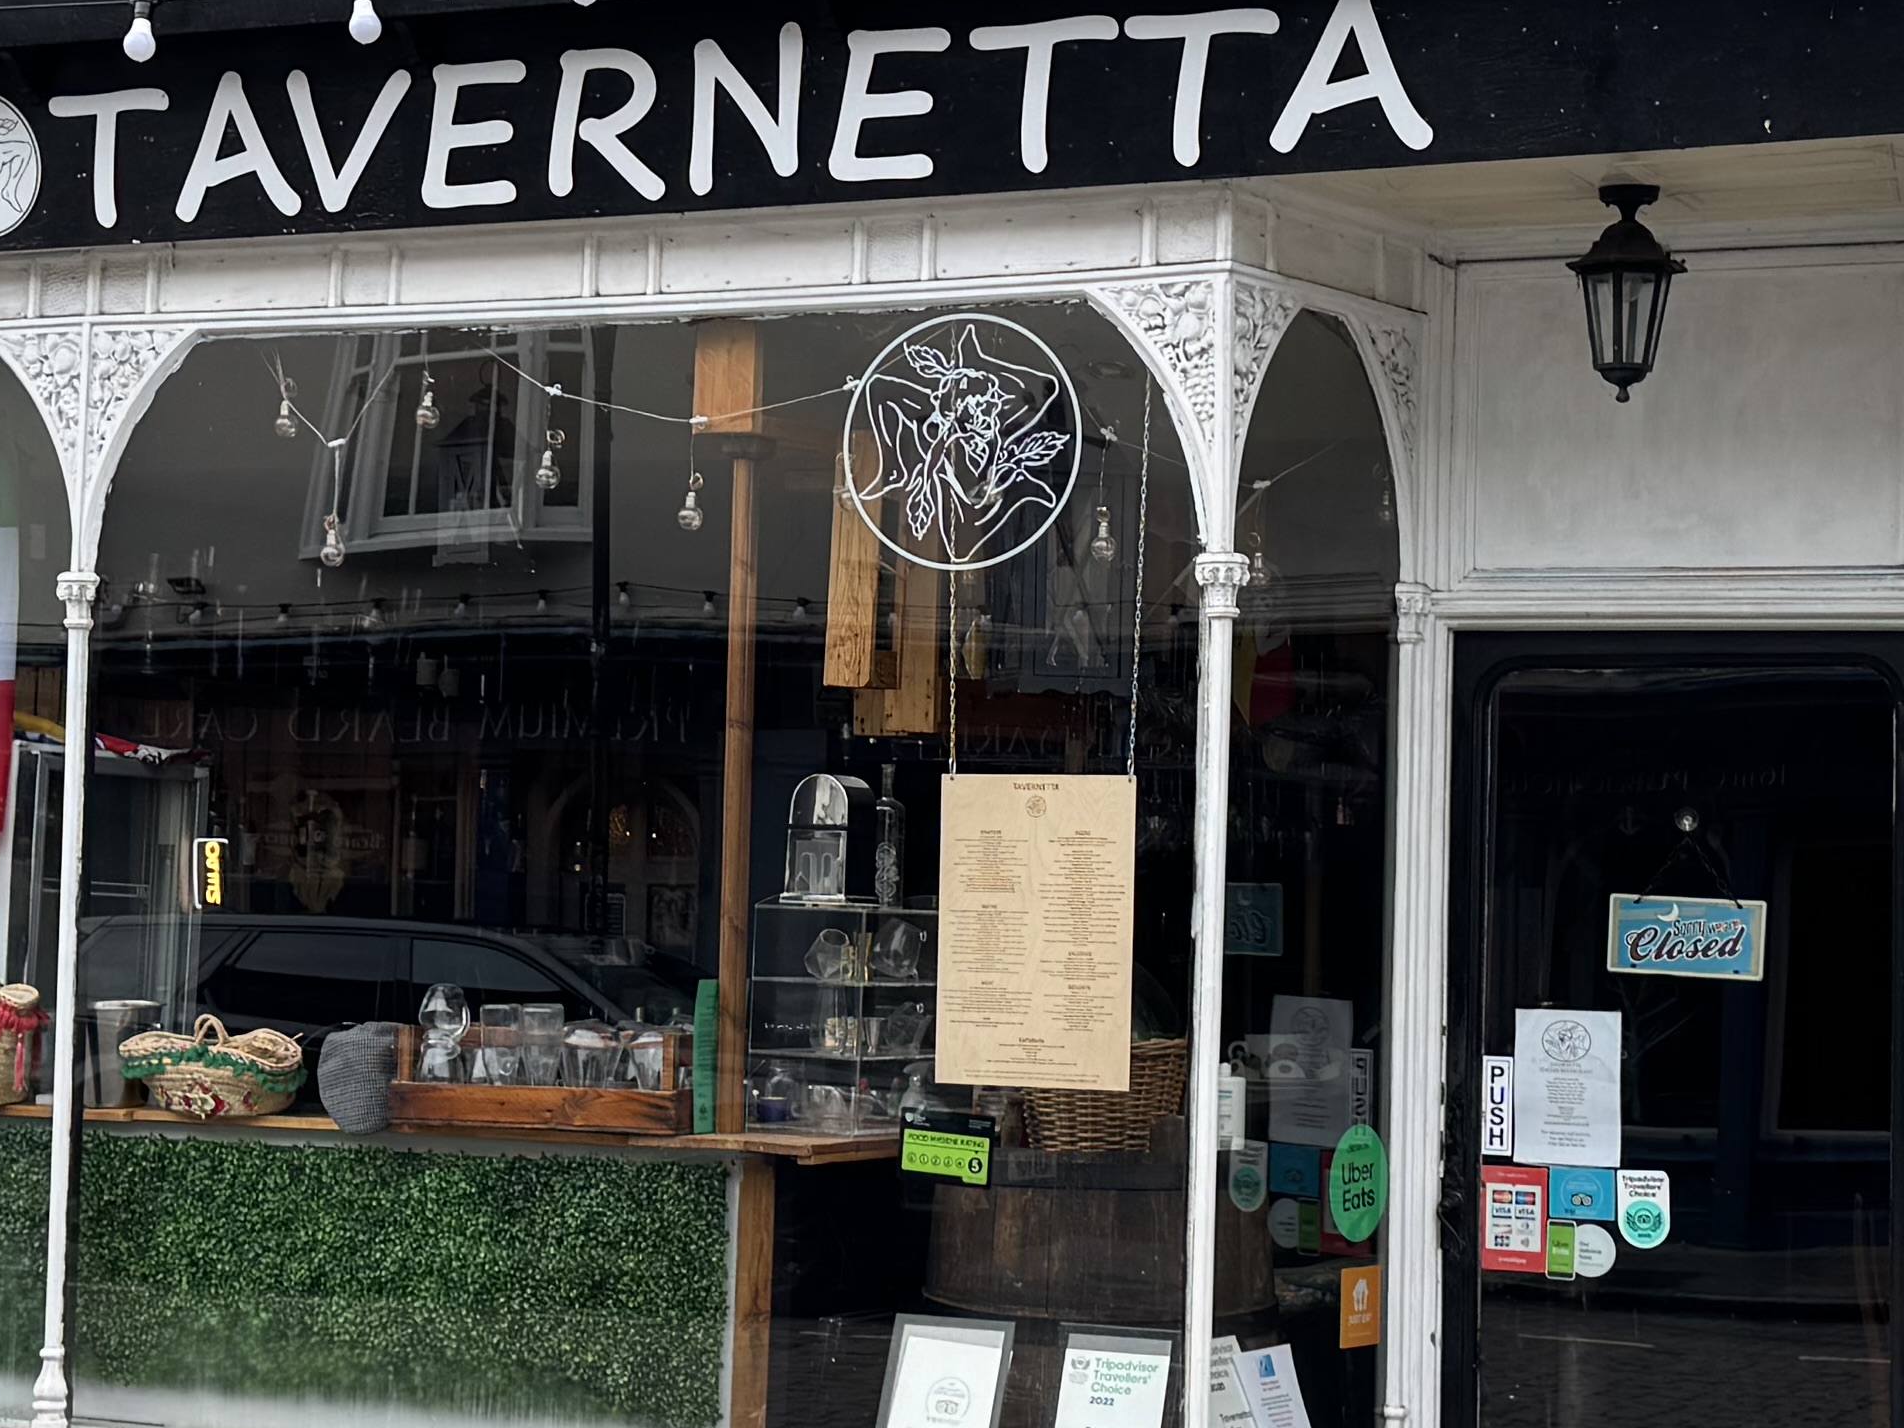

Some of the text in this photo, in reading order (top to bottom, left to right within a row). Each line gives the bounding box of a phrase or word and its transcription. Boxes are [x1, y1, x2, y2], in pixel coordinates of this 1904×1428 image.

[1673, 919, 1706, 937] Sorry
[1626, 925, 1746, 963] Closed
[1489, 1065, 1505, 1147] PUSH
[1341, 1162, 1375, 1185] Uber
[1343, 1187, 1376, 1212] Eats
[1095, 1358, 1159, 1373] Tripadvisor
[1091, 1382, 1132, 1395] Choice
[1089, 1396, 1115, 1406] 2022
